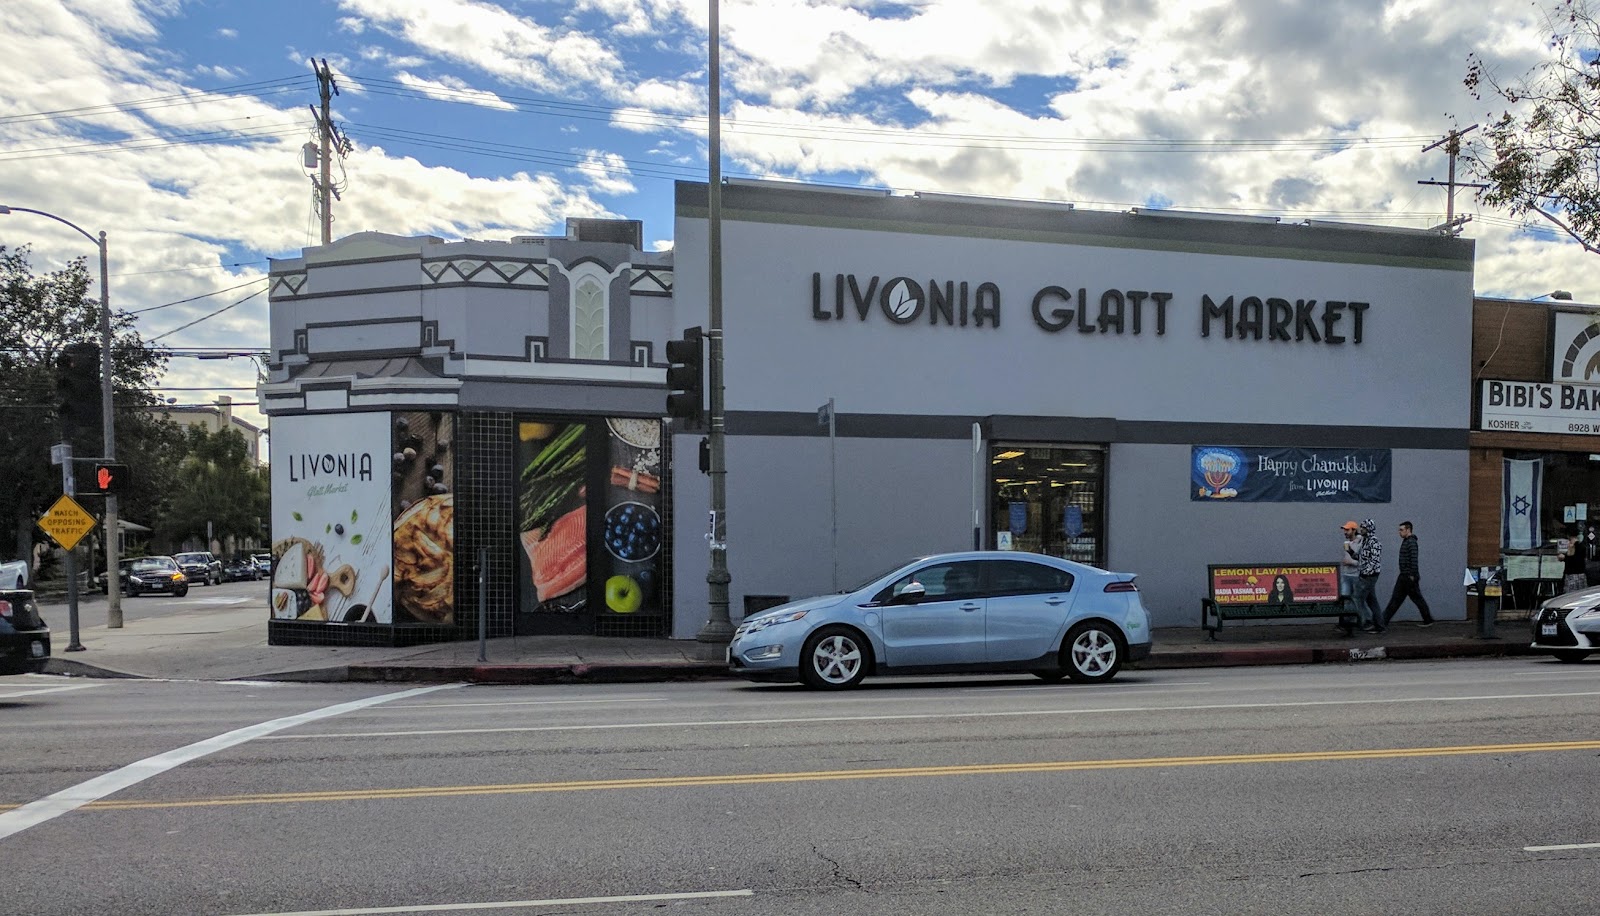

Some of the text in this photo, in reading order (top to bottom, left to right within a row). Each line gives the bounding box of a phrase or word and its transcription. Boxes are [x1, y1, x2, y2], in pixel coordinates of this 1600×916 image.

[812, 272, 1370, 344] LIVONIA GLATT MARKET
[1489, 381, 1552, 409] BIBI'S
[1488, 419, 1519, 429] KOSHER
[1568, 423, 1590, 432] 8928
[289, 452, 372, 482] LIVONIA
[1257, 454, 1377, 477] Happy Chanukkah
[1307, 479, 1349, 491] LIVONIA
[47, 518, 86, 526] OPPOSING
[51, 527, 83, 535] TRAFFIC
[1214, 566, 1337, 577] LEMON LAW ATTORNEY
